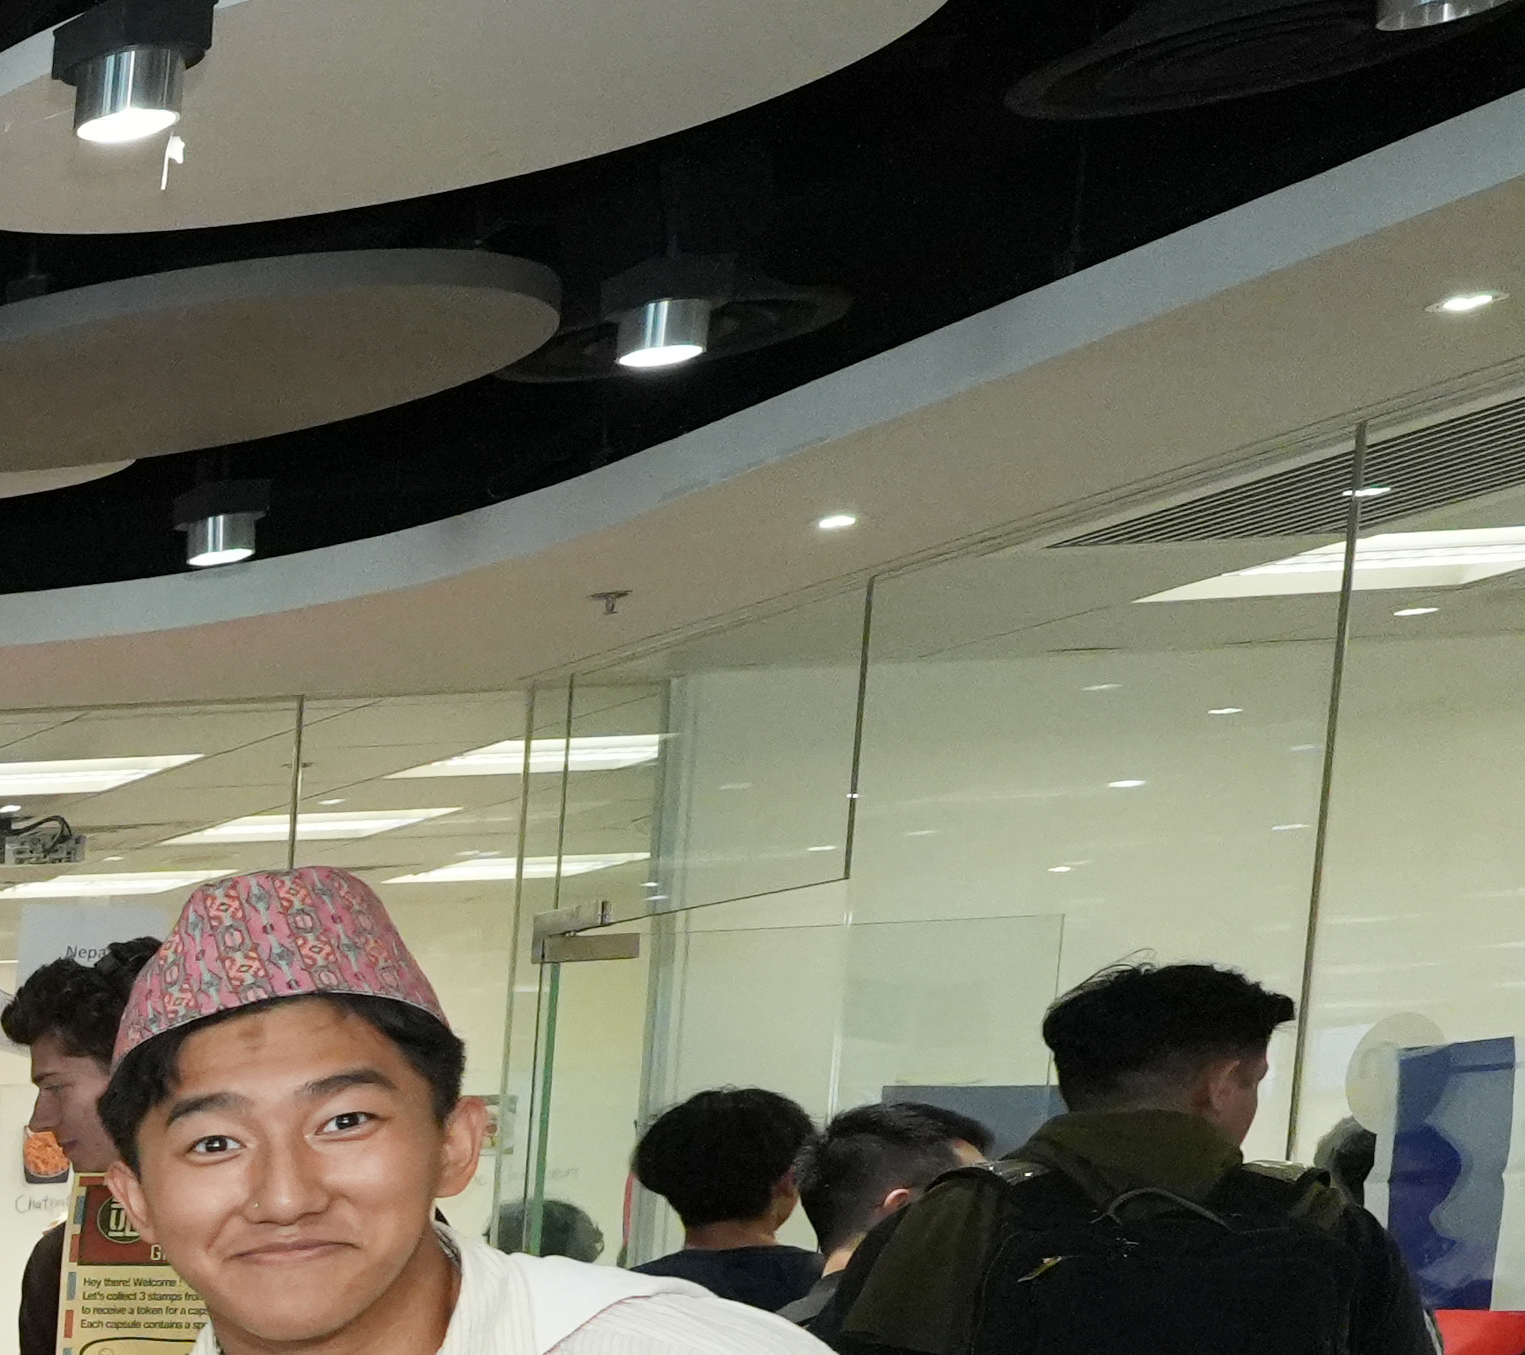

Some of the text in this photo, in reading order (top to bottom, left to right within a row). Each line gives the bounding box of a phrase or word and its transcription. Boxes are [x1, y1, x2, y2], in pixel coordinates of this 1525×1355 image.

[83, 1276, 176, 1288] Hey there! Welcome
[82, 1291, 104, 1301] Let's
[106, 1291, 137, 1301] collect
[139, 1291, 146, 1301] 3
[148, 1292, 183, 1303] stamps
[81, 1305, 88, 1315] to
[89, 1305, 126, 1315] receive
[136, 1305, 164, 1315] token
[165, 1305, 179, 1315] for
[81, 1319, 104, 1329] Each
[105, 1320, 141, 1331] capsule
[143, 1320, 183, 1329] contains
